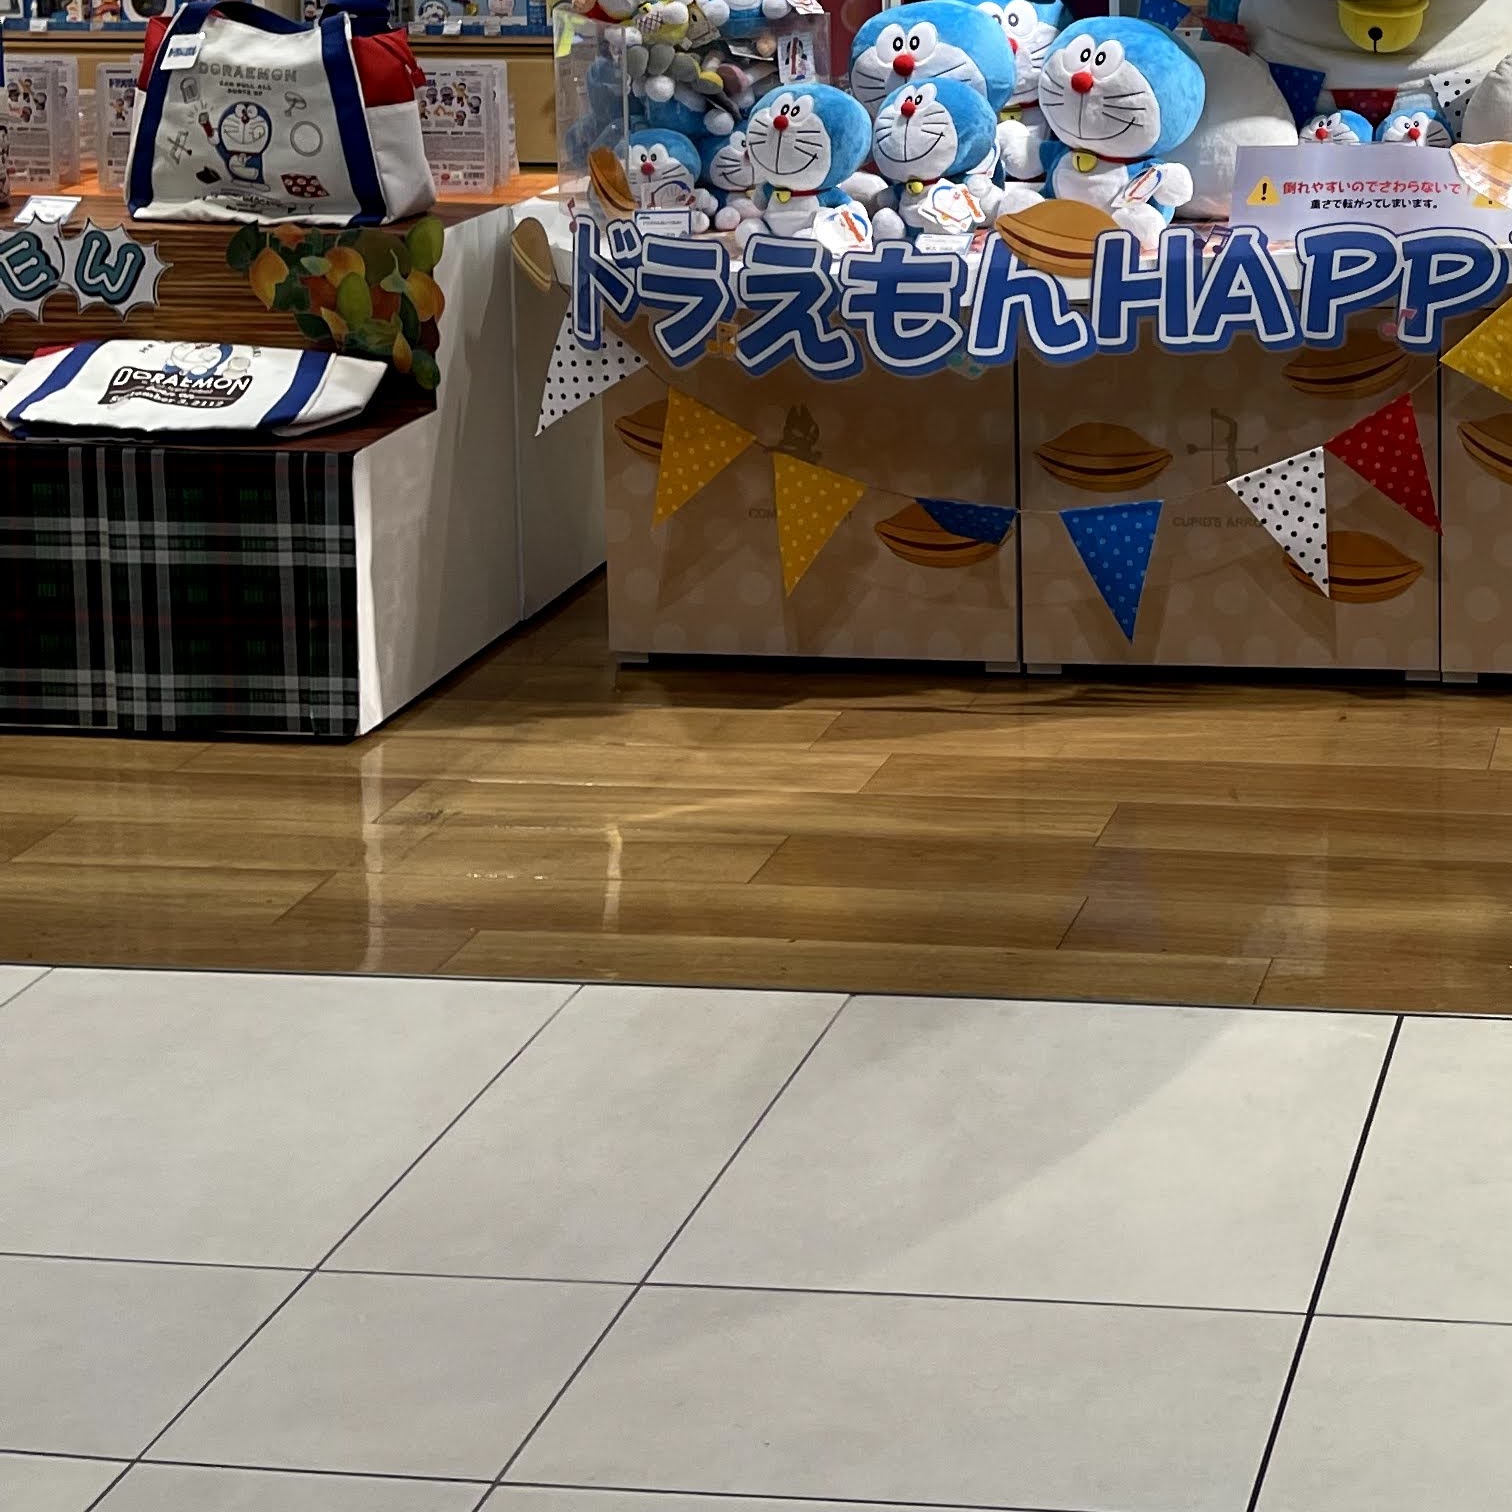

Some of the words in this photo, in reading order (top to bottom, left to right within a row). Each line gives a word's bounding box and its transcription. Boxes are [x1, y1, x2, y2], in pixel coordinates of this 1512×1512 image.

[1310, 198, 1439, 210] 重さで転がってしまいます。
[569, 215, 1093, 378] ドラえもん
[113, 367, 250, 396] DORAEMON
